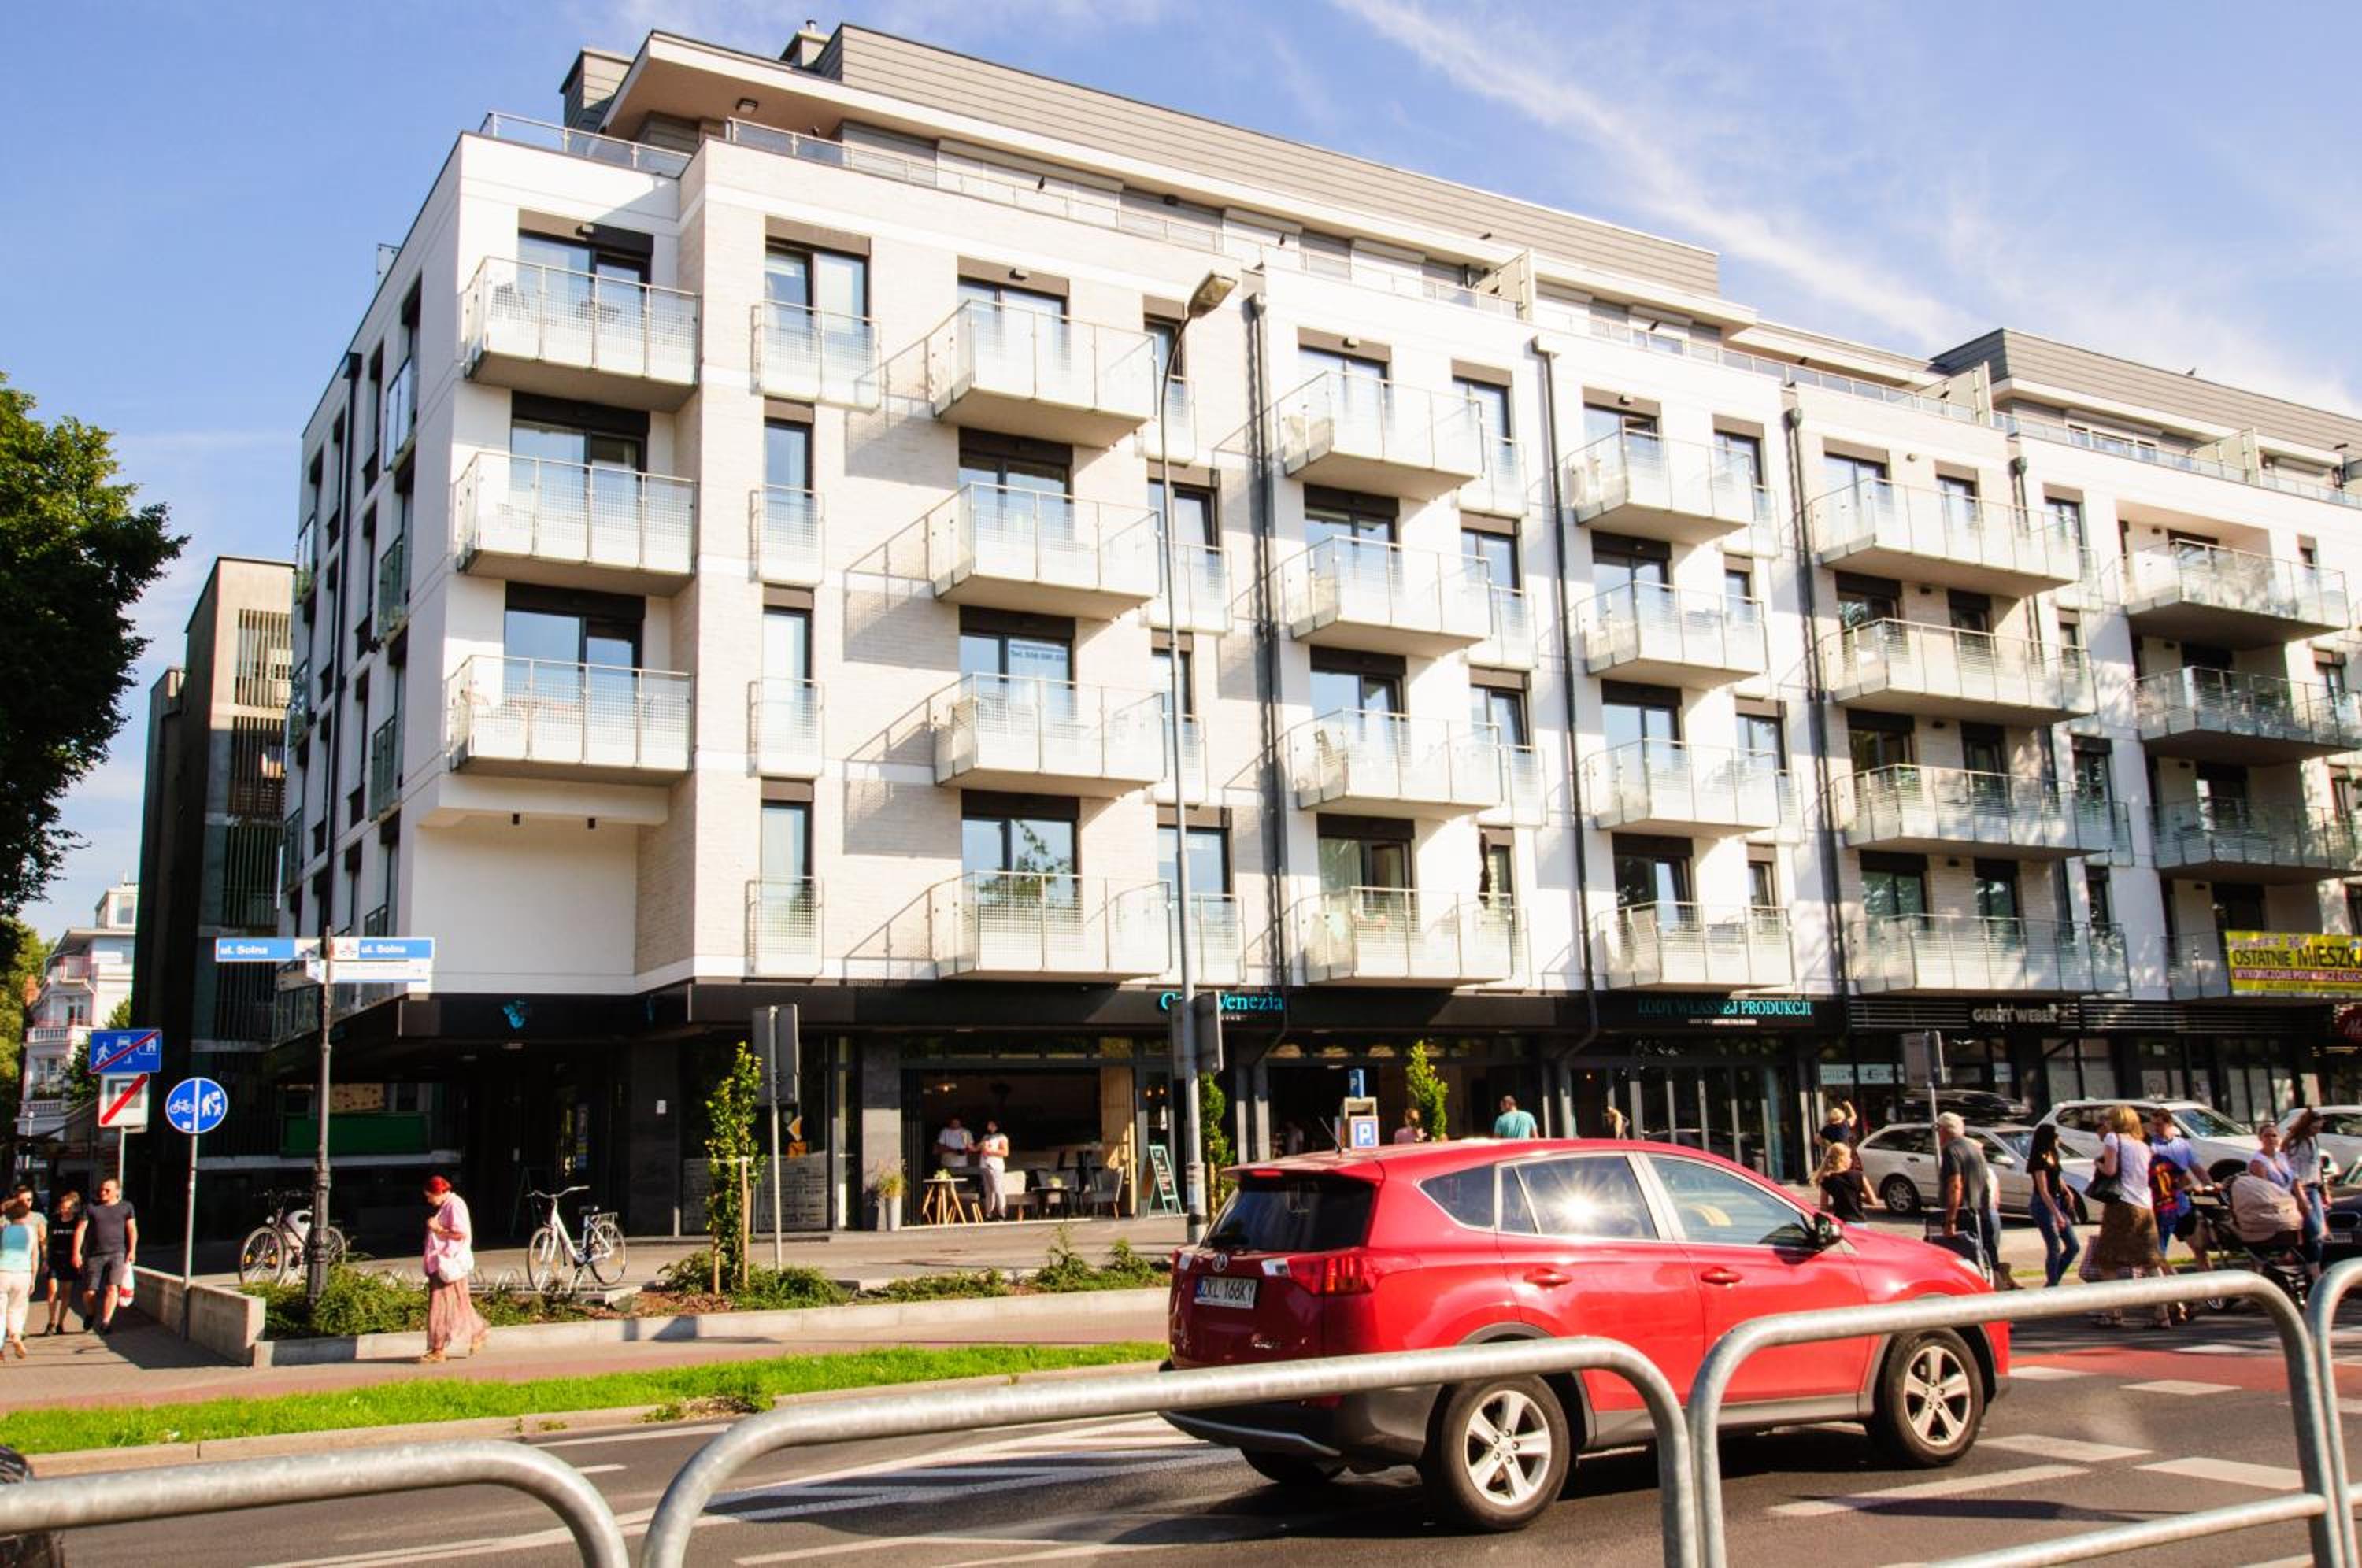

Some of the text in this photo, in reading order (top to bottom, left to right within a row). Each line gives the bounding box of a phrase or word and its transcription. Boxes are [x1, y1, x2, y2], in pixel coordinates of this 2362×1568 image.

[2233, 945, 2362, 967] OSTATNIE MIESZK
[1740, 1000, 1812, 1015] PRODUKCJI
